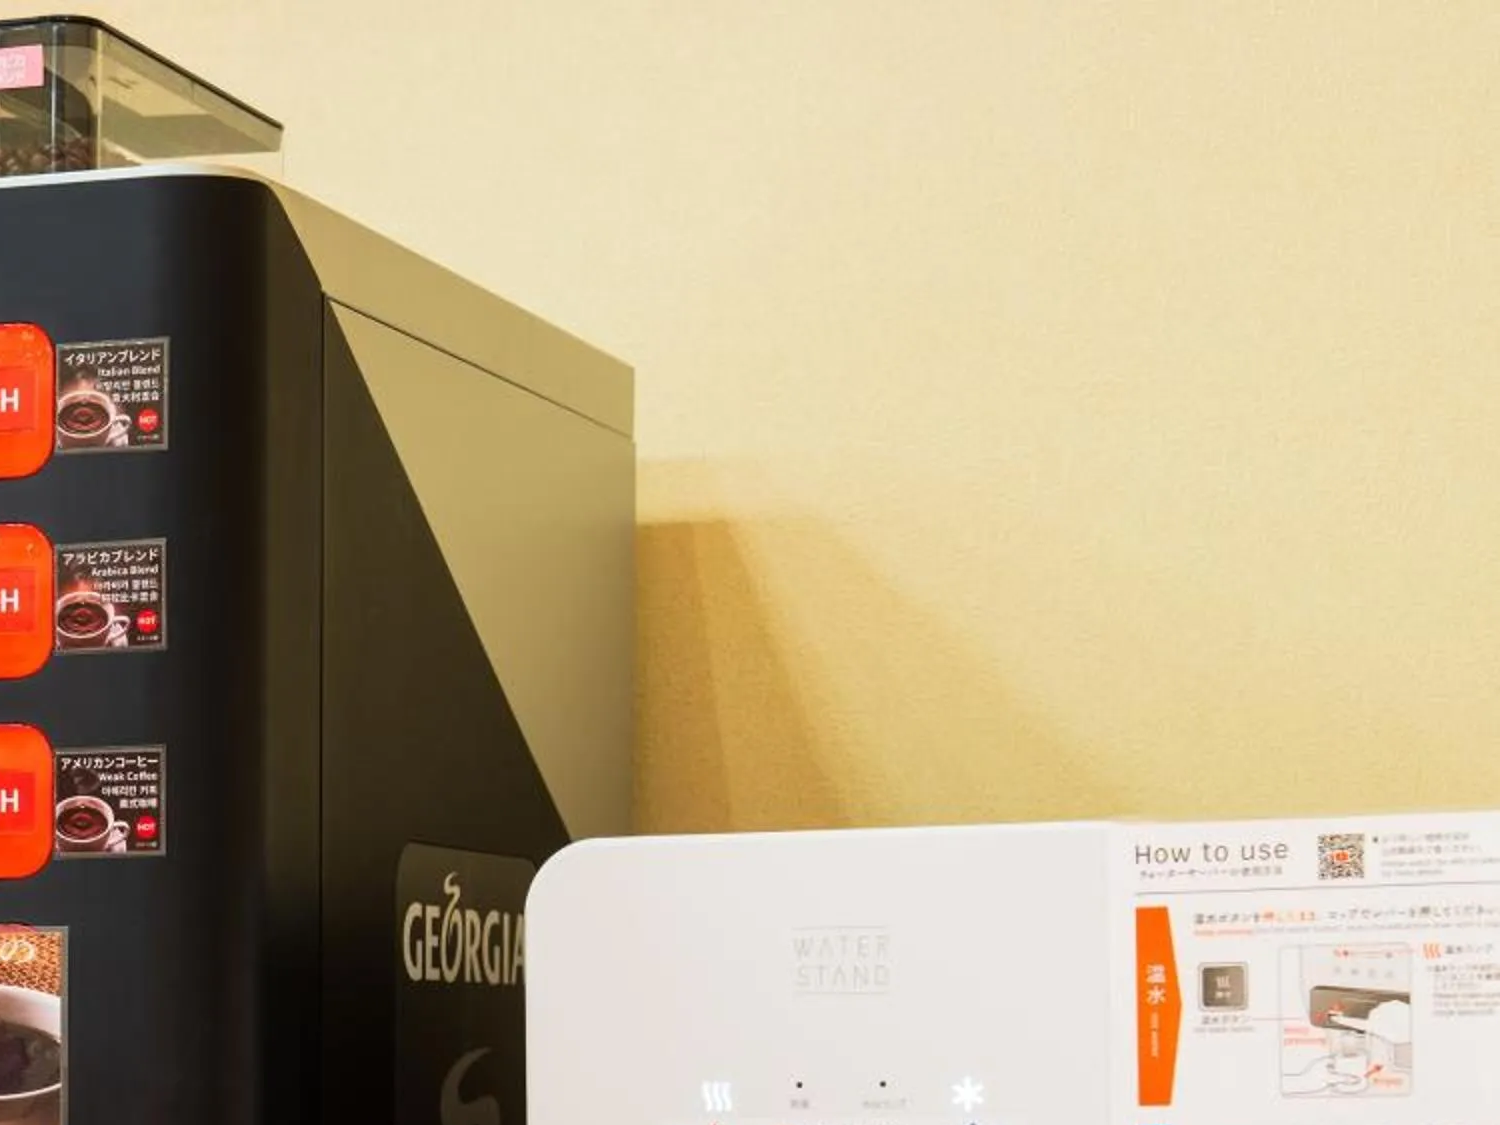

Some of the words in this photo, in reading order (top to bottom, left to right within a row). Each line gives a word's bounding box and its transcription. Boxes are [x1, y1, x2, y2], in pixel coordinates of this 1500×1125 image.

[64, 349, 161, 366] イタリアンブレンド
[62, 547, 159, 566] アラビカブレンド
[61, 755, 159, 771] アメリカンコーヒー
[1135, 843, 1190, 864] How
[1203, 842, 1228, 862] to
[1241, 841, 1289, 861] use
[793, 934, 891, 958] WATER
[795, 964, 891, 988] STAND
